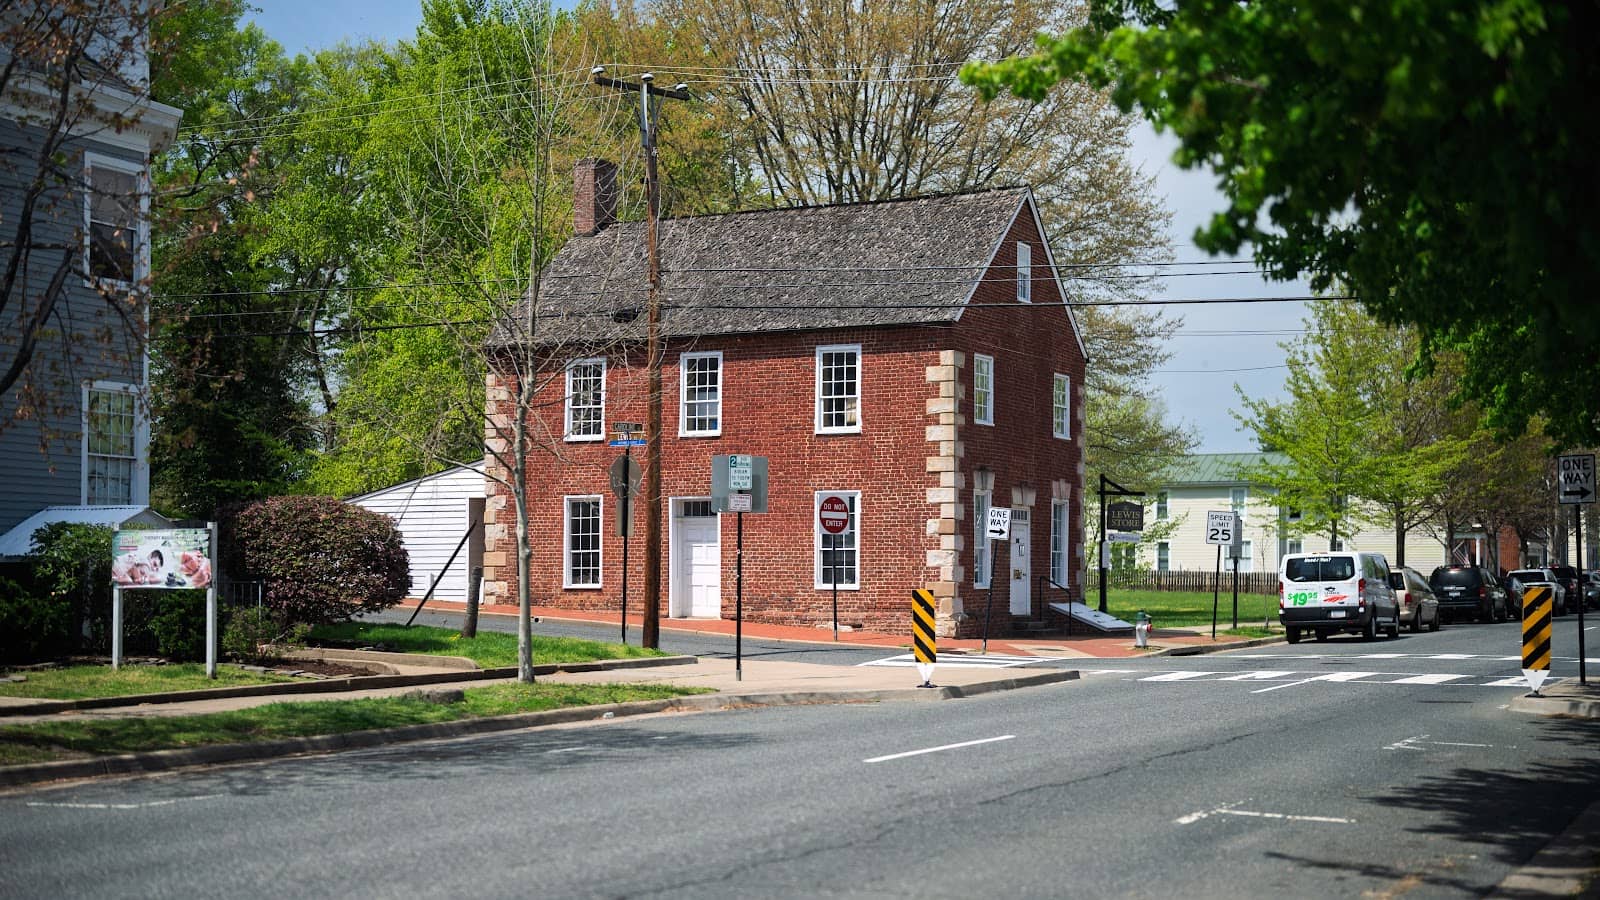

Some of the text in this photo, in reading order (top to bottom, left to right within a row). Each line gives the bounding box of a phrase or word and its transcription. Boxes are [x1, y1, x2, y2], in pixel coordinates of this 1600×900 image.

[731, 456, 737, 466] 2
[1562, 459, 1590, 471] ONE
[1563, 472, 1591, 484] WAY
[990, 510, 1007, 518] ONE
[1111, 510, 1140, 519] LEWIS
[990, 519, 1007, 527] WAY
[1111, 519, 1140, 527] STORE
[1209, 528, 1231, 541] 25
